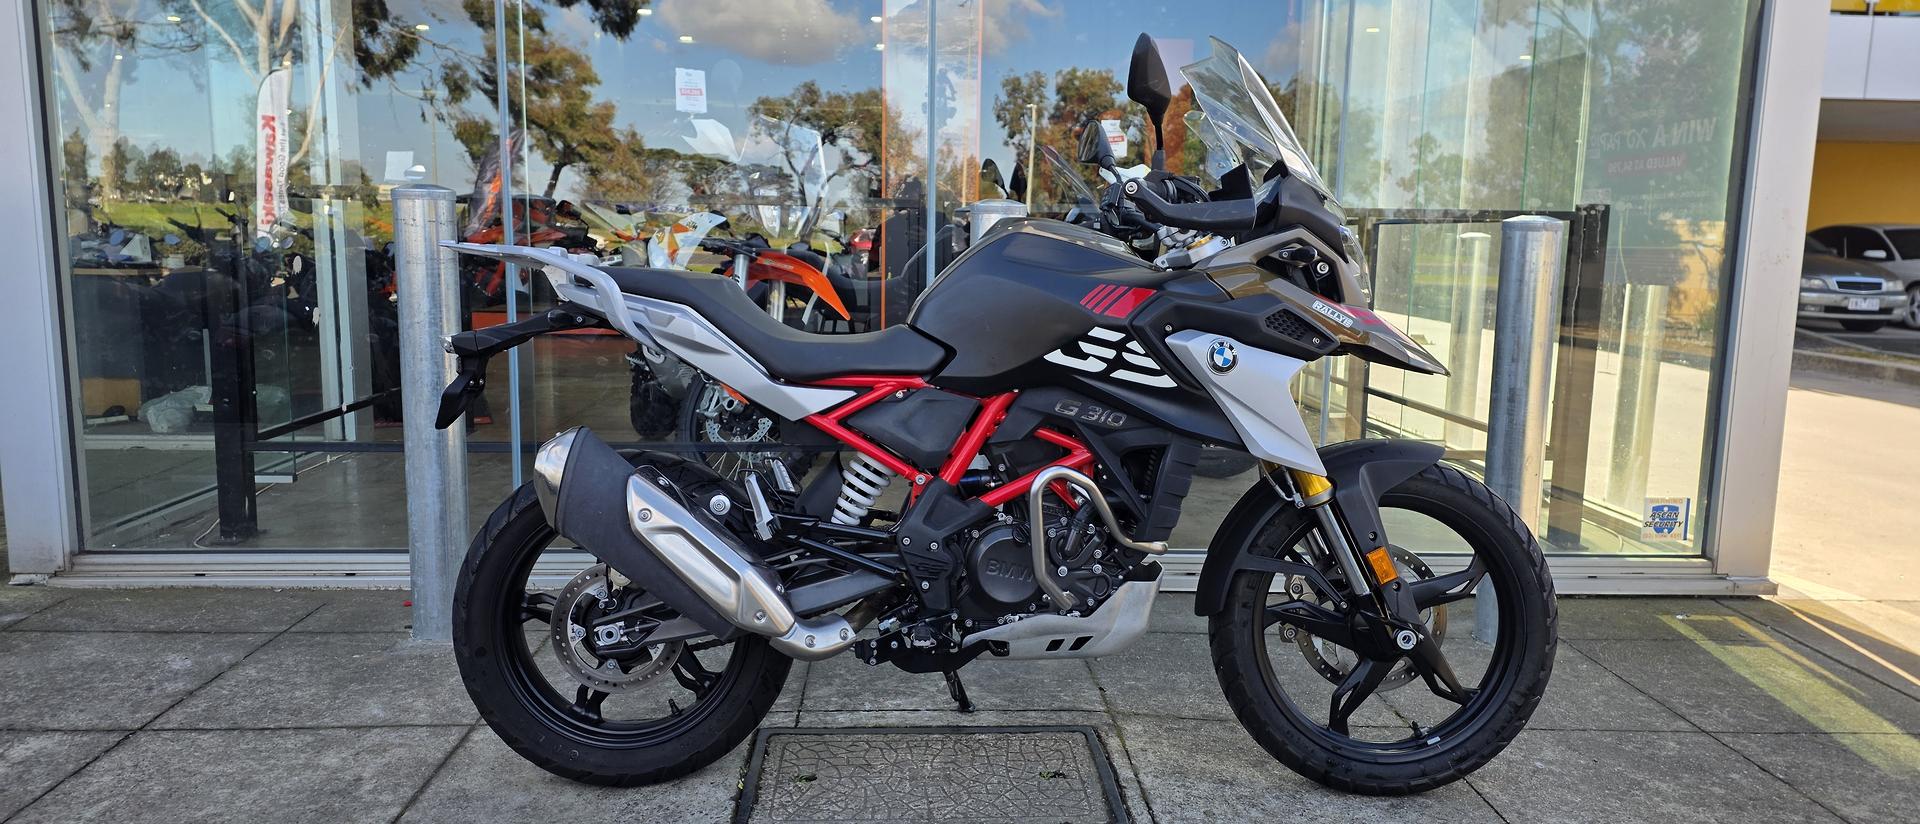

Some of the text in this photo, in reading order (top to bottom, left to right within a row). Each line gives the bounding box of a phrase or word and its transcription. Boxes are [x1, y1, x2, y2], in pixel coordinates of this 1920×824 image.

[1312, 301, 1353, 328] RALLYE
[1043, 326, 1178, 388] GS
[1213, 340, 1238, 356] BMW
[1054, 399, 1127, 427] G 310
[1643, 520, 1684, 528] SECURITY
[1650, 511, 1680, 519] ASCAN
[985, 560, 1034, 583] BMW
